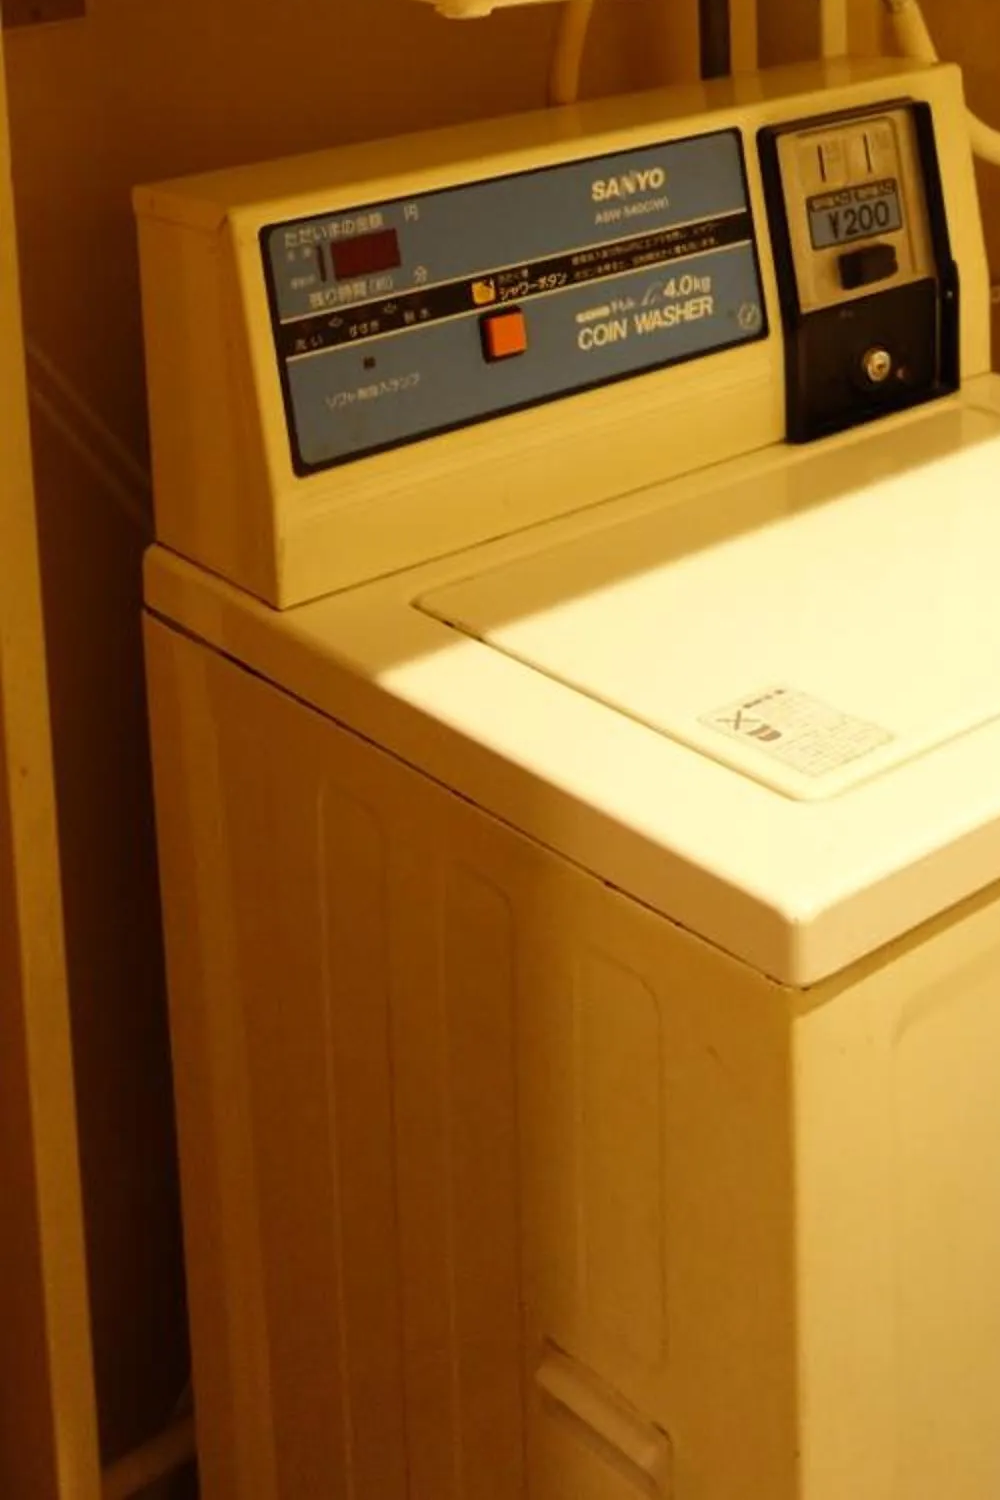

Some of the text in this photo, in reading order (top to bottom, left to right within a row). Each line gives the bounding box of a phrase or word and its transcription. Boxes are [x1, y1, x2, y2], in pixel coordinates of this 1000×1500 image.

[591, 167, 666, 202] SANYO
[284, 205, 420, 249] ただいまの金額 円
[827, 199, 890, 239] ¥200
[413, 265, 428, 284] 分
[498, 272, 568, 301] シャワーボタン
[663, 274, 712, 299] 4.0kg
[577, 318, 629, 351] COIN
[633, 295, 714, 335] WASHER
